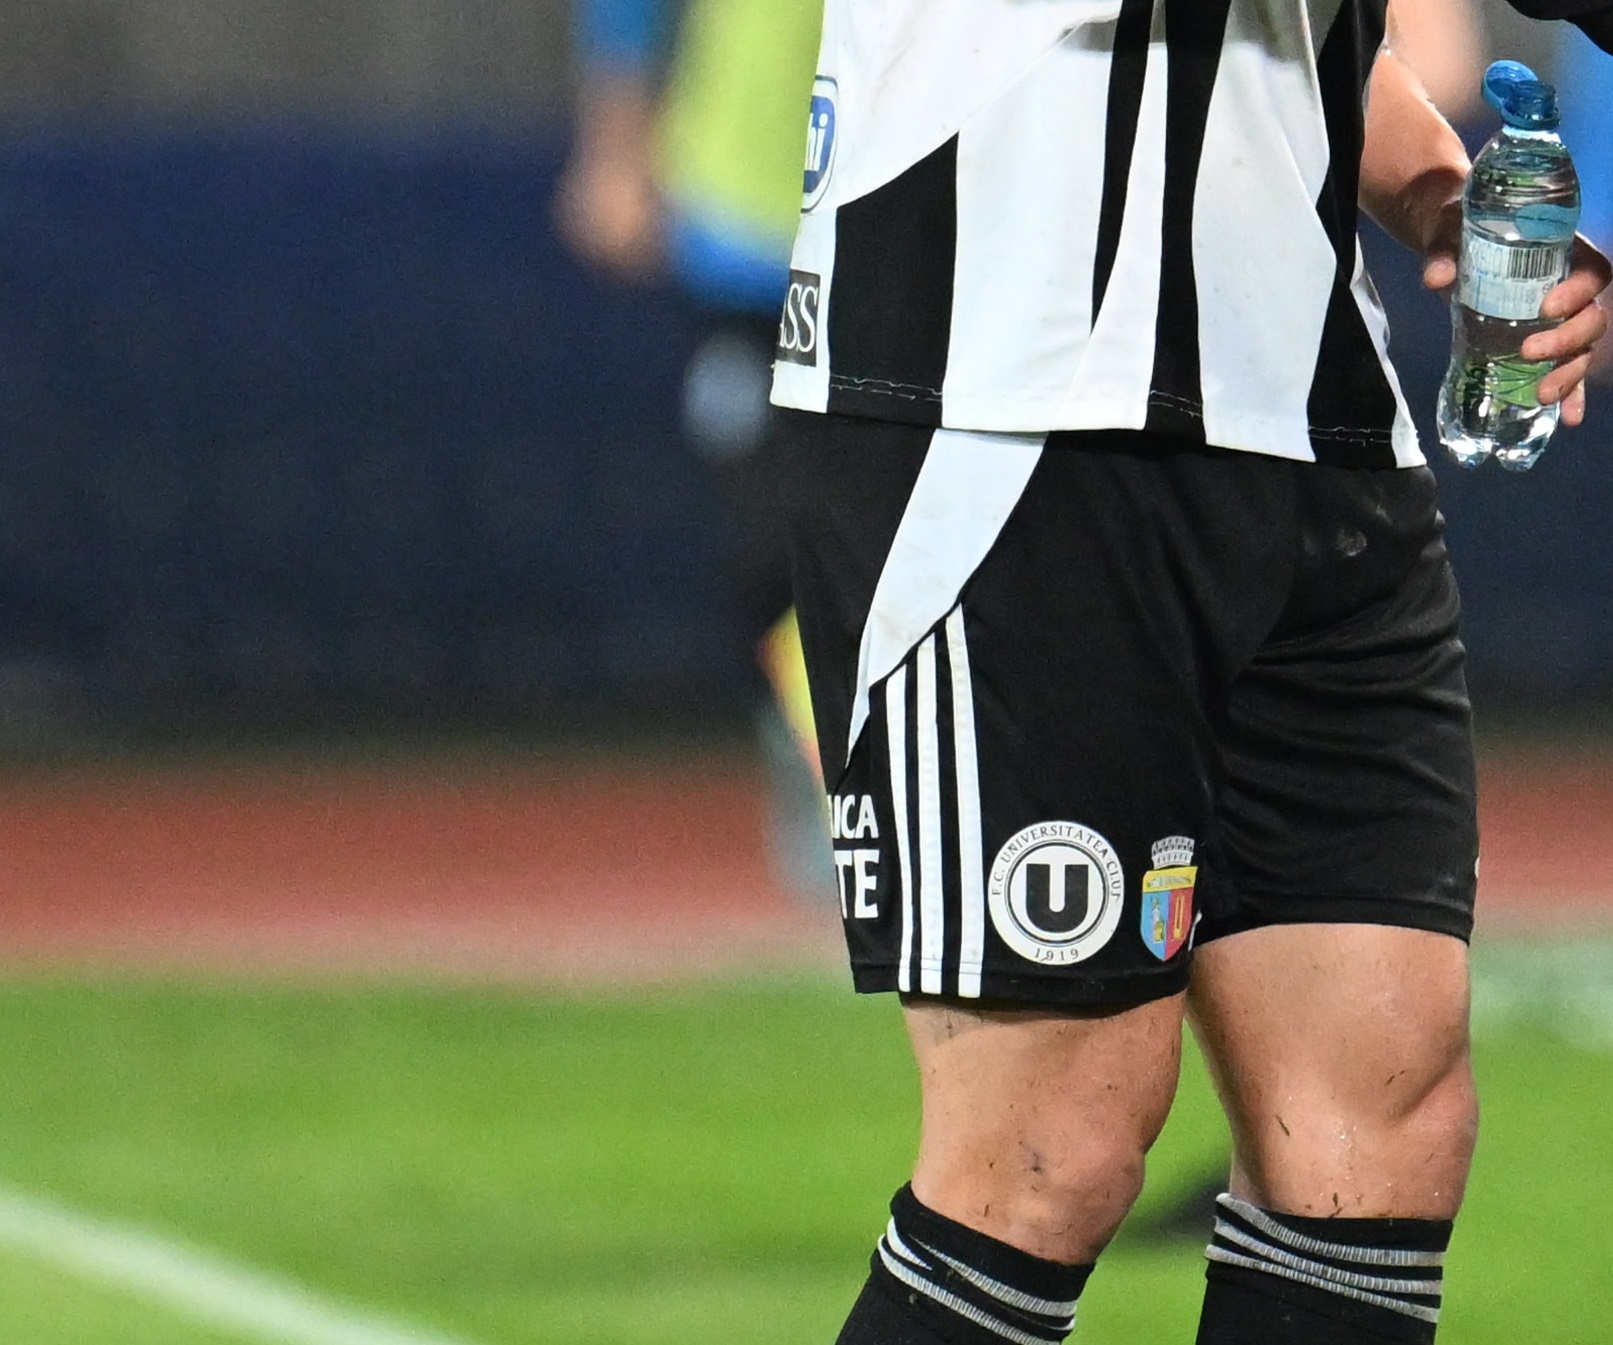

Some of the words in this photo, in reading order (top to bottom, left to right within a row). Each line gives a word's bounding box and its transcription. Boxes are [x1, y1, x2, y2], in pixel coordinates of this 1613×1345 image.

[1003, 825, 1109, 864] UNIVERSITATEA
[1106, 860, 1121, 902] CLUJ
[1026, 863, 1089, 933] U
[1034, 948, 1079, 962] 1919
